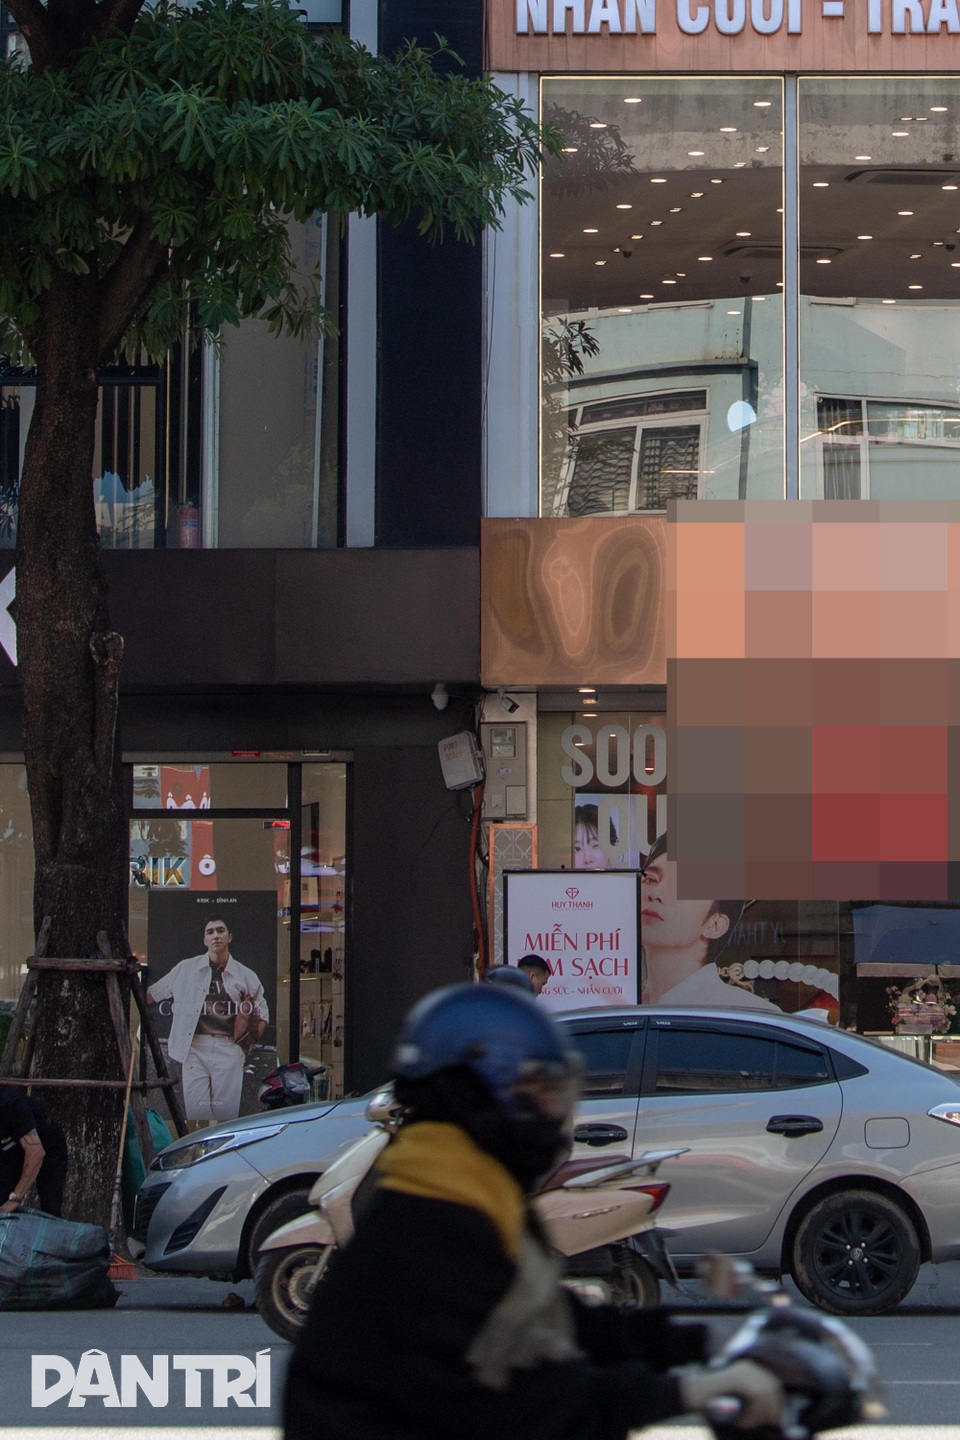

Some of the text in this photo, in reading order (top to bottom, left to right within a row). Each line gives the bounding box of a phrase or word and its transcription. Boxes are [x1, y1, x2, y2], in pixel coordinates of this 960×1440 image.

[551, 901, 594, 909] HUY THANH
[524, 923, 622, 951] MIỄN PHÍ
[571, 958, 629, 980] SẠCH
[553, 984, 570, 995] SỨC
[577, 984, 600, 995] NHẪN
[602, 985, 623, 995] CƯỚI
